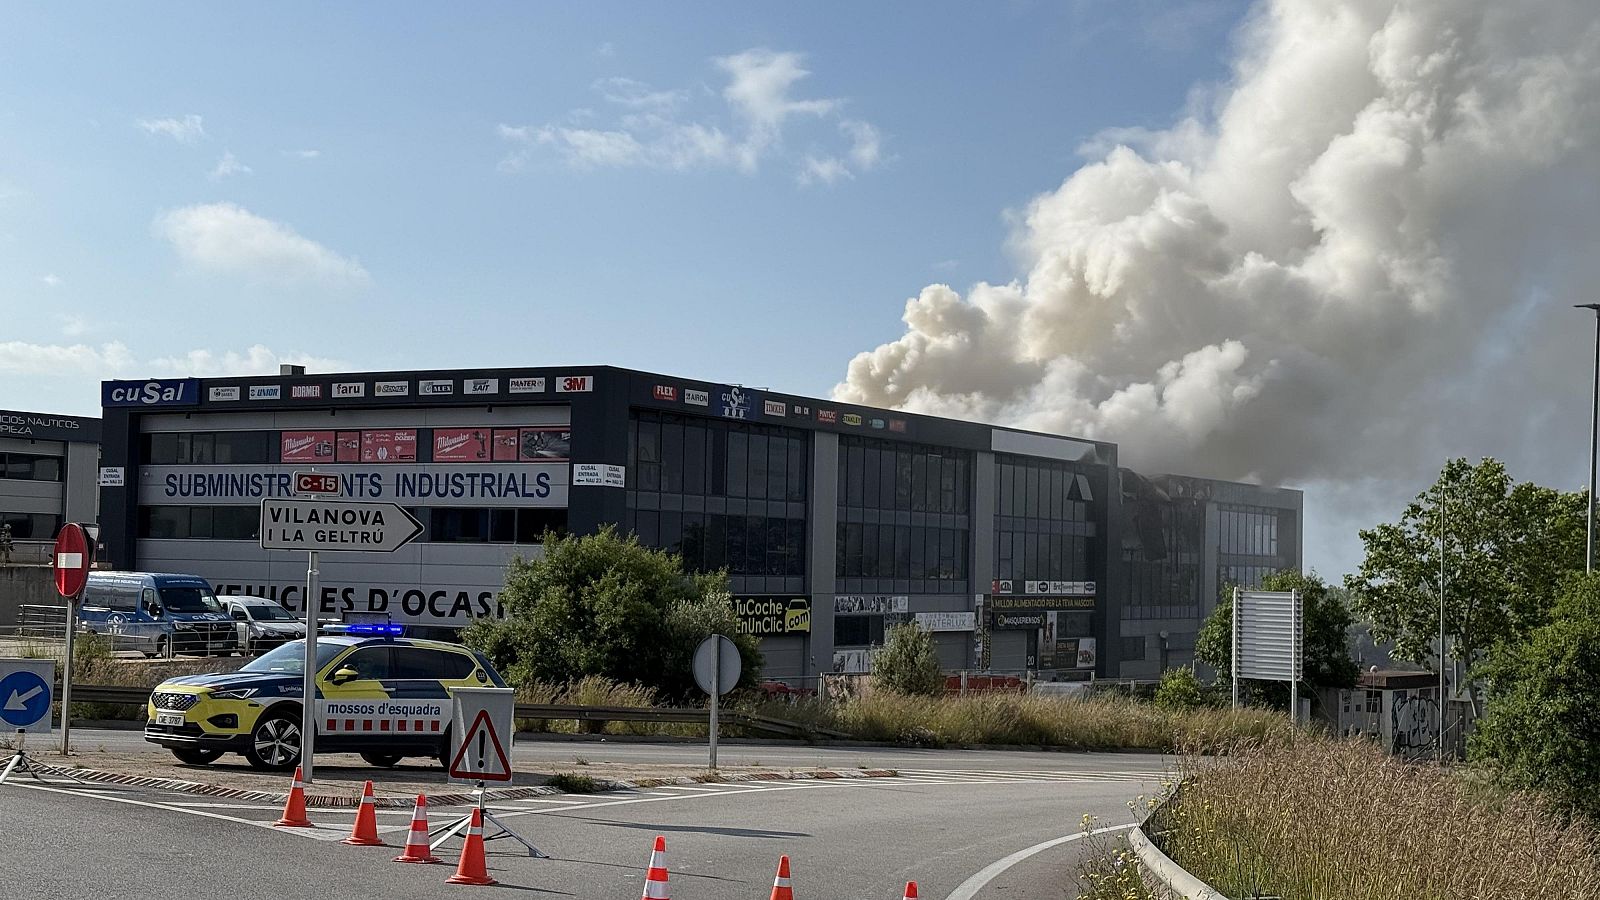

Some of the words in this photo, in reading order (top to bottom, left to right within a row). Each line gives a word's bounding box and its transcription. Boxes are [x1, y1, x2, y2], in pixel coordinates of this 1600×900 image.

[336, 383, 360, 397] faru
[472, 384, 490, 392] SAIT
[510, 380, 537, 388] PANTER
[562, 376, 586, 391] 3M
[656, 385, 673, 396] FLEX
[111, 382, 185, 404] cuSal
[292, 385, 321, 398] DORMER
[165, 473, 383, 498] SUBMINISTRNTS
[395, 472, 551, 498] INDUSTRIALS
[299, 476, 337, 491] C-15
[269, 507, 385, 526] VILANOVA
[268, 528, 273, 541] I
[281, 529, 305, 542] LA
[314, 528, 384, 544] GELTRÚ
[735, 599, 783, 616] TuCoche
[996, 599, 1013, 608] MILLOR
[1046, 599, 1055, 608] PER
[1055, 599, 1062, 608] LA
[1074, 599, 1095, 608] MASCOTA
[735, 616, 783, 634] EnUnClic
[786, 610, 809, 629] .com
[1027, 655, 1035, 666] 20
[326, 702, 375, 716] mossos
[378, 702, 441, 718] d'esquadra
